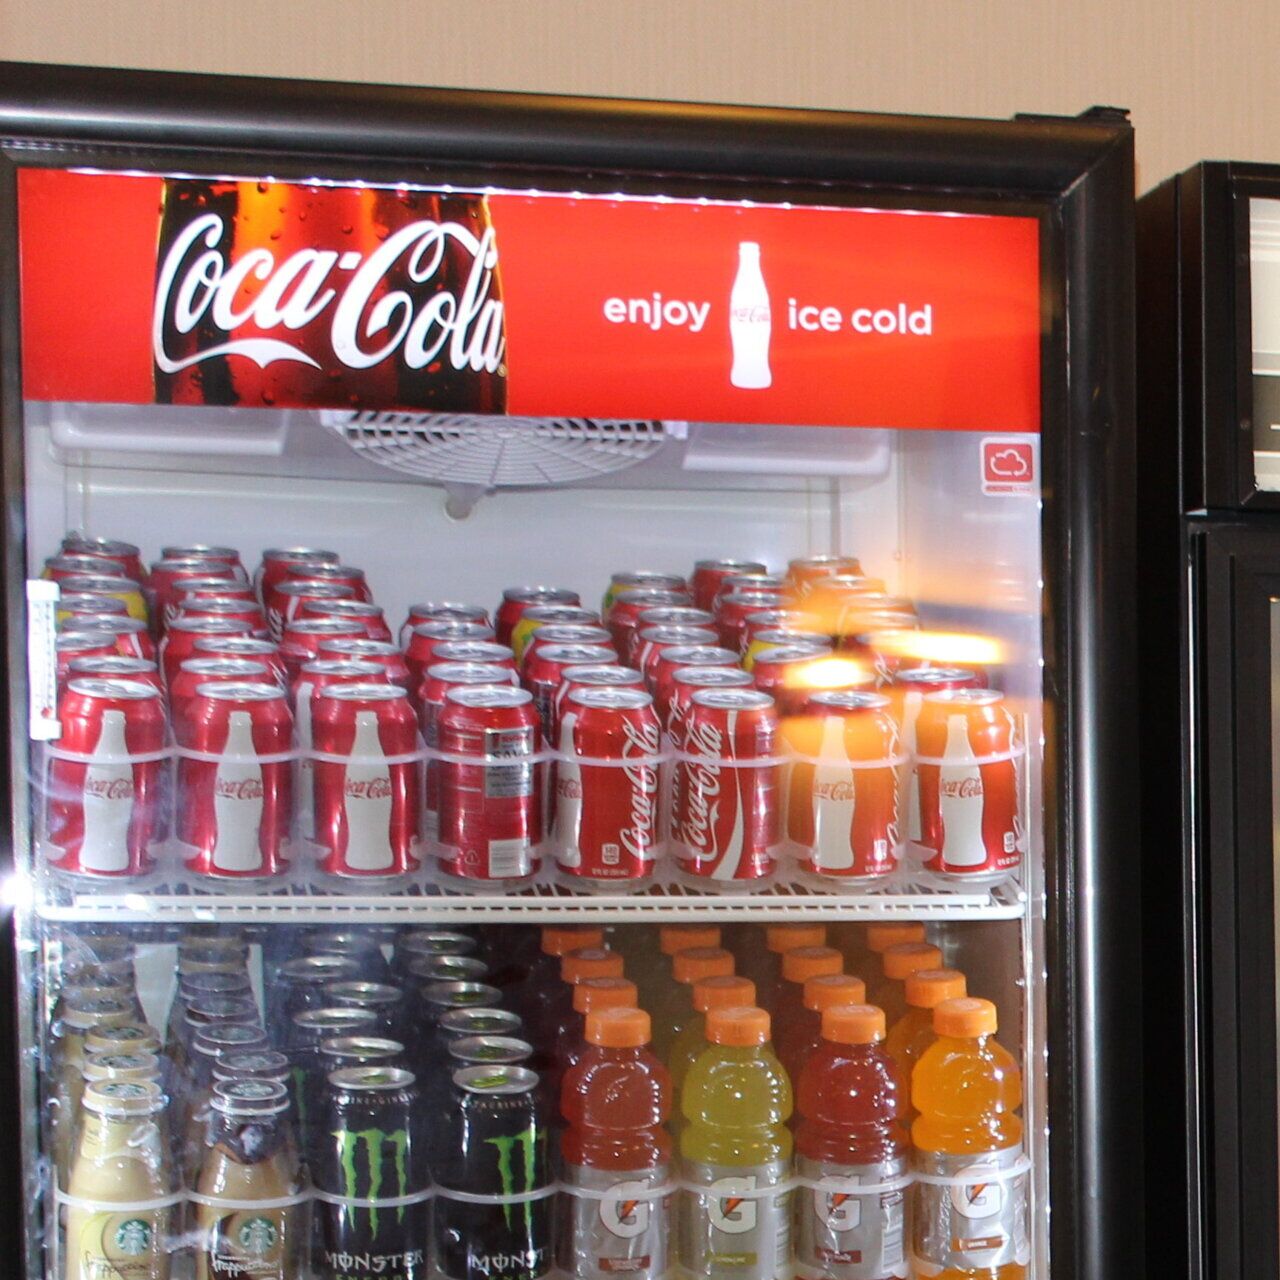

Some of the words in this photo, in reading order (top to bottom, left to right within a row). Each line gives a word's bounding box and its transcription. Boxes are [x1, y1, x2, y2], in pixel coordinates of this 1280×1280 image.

[151, 213, 508, 374] Coca-Cola
[603, 292, 711, 332] enjoy
[788, 298, 842, 332] ice
[851, 302, 933, 335] cold
